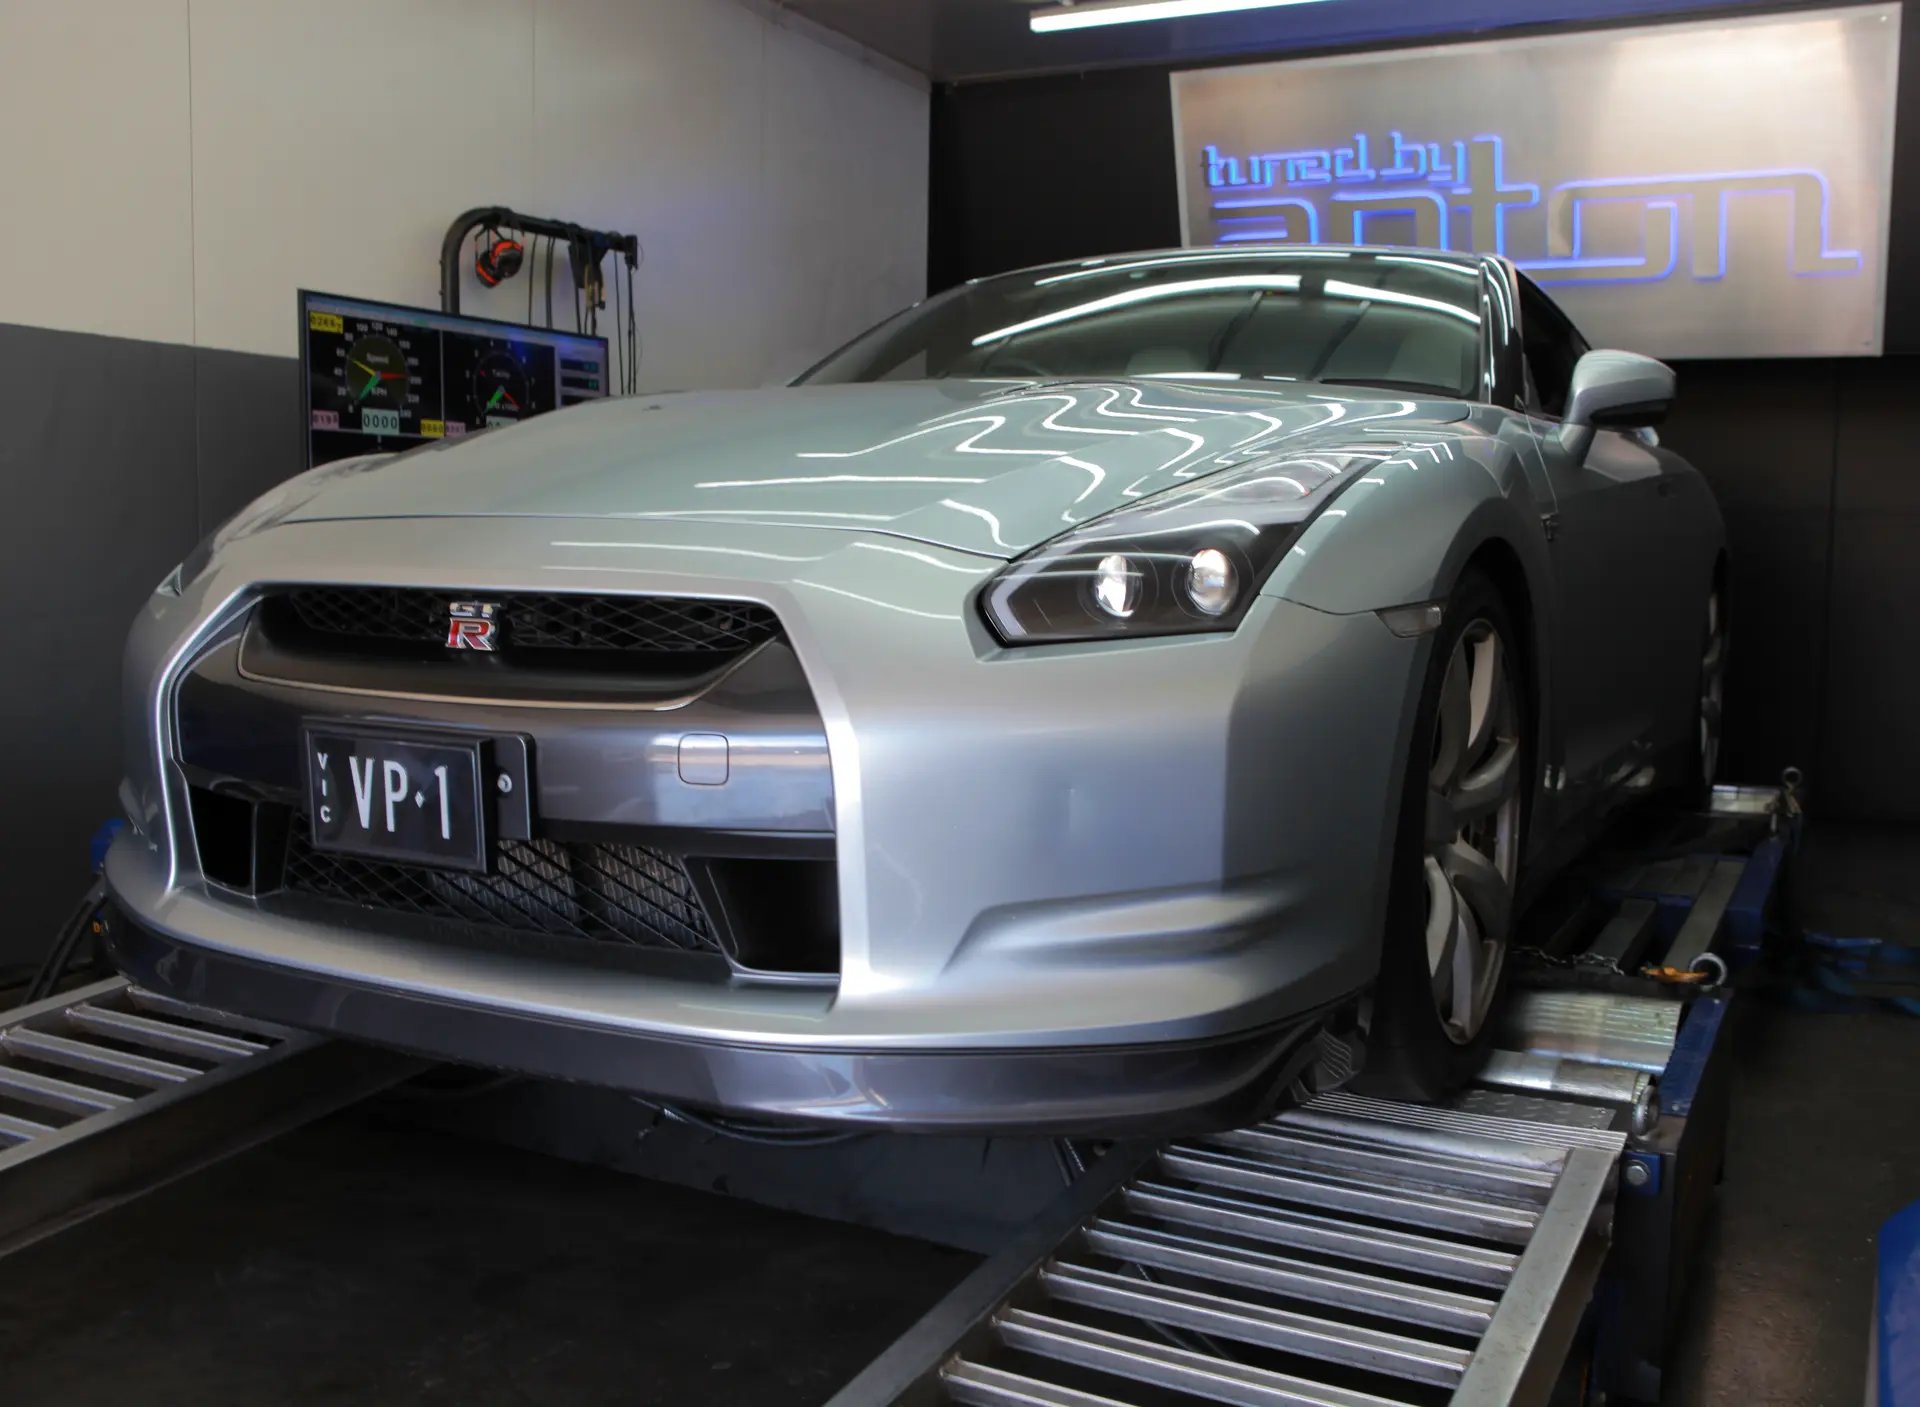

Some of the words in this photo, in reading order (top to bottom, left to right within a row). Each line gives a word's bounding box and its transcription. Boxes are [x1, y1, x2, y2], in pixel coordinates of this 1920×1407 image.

[1379, 130, 1466, 188] by
[363, 413, 398, 429] 0000
[317, 752, 331, 823] VIC
